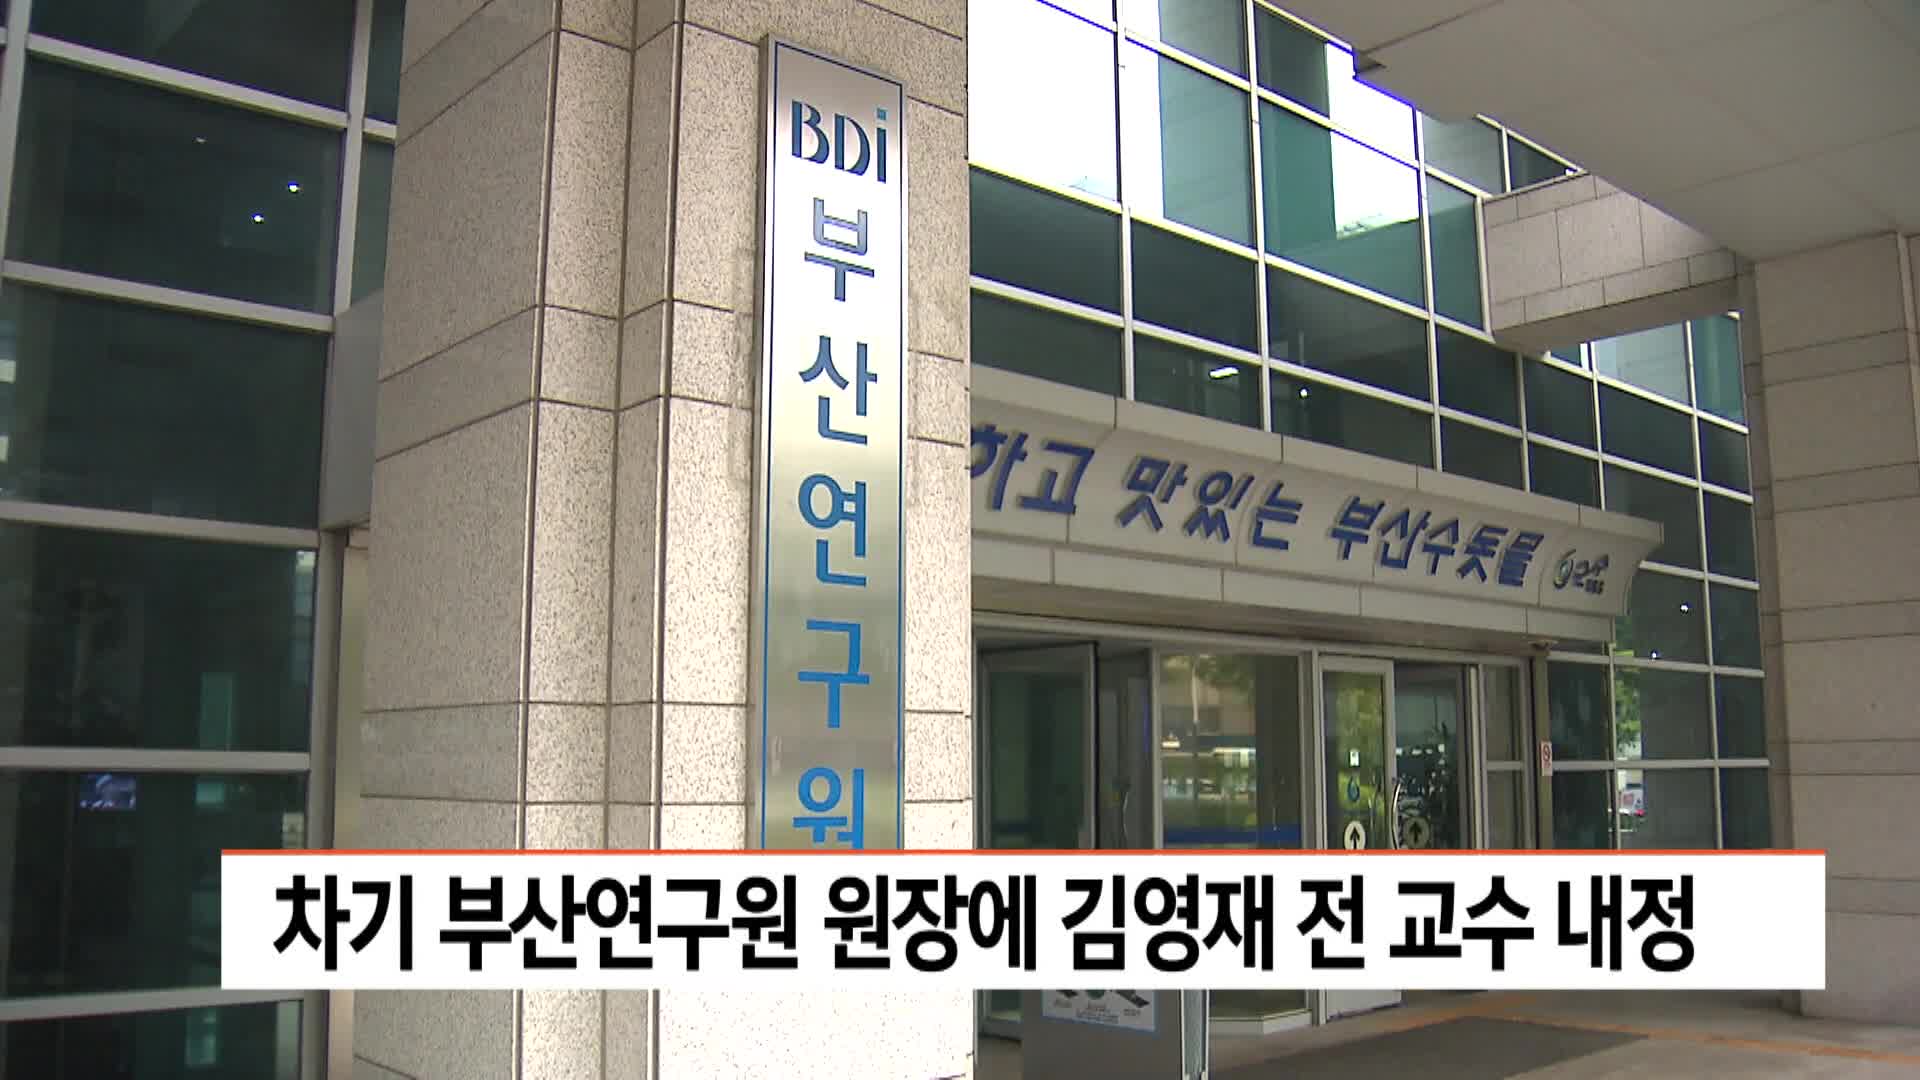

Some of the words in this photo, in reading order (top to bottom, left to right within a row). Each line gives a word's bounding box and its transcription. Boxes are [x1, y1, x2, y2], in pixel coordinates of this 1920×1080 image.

[792, 197, 878, 850] 부산연구원
[1117, 456, 1303, 551] 맛있는
[1328, 495, 1545, 587] 부산수돗물
